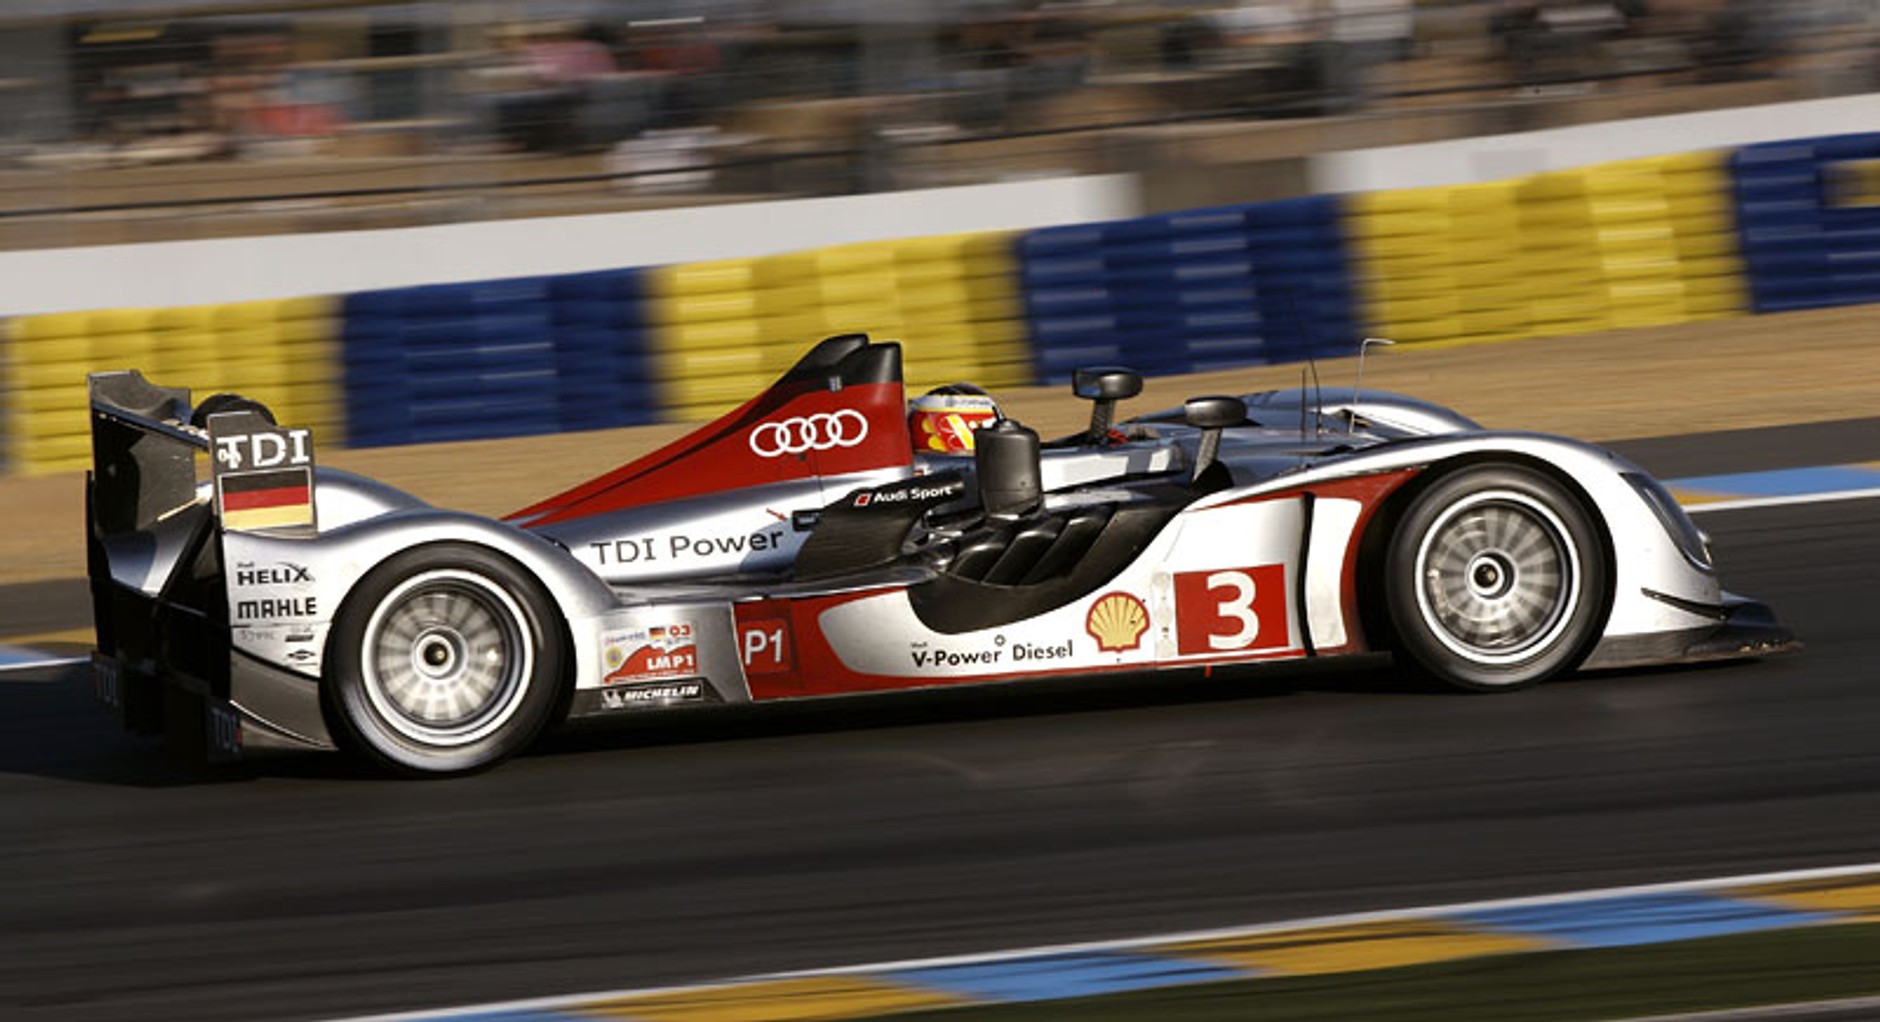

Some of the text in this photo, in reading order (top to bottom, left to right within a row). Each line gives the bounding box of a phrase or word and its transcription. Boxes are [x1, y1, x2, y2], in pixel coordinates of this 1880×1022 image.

[216, 429, 310, 469] TDI
[873, 485, 953, 502] Audi Sport
[590, 529, 784, 565] TDI Power
[237, 567, 311, 586] HELIX
[237, 597, 317, 619] MAHLE
[1206, 570, 1260, 650] 3
[744, 628, 783, 667] P1
[911, 639, 1074, 668] V-Power Diesel
[646, 653, 695, 671] LMP1
[623, 685, 699, 701] MICHELIN
